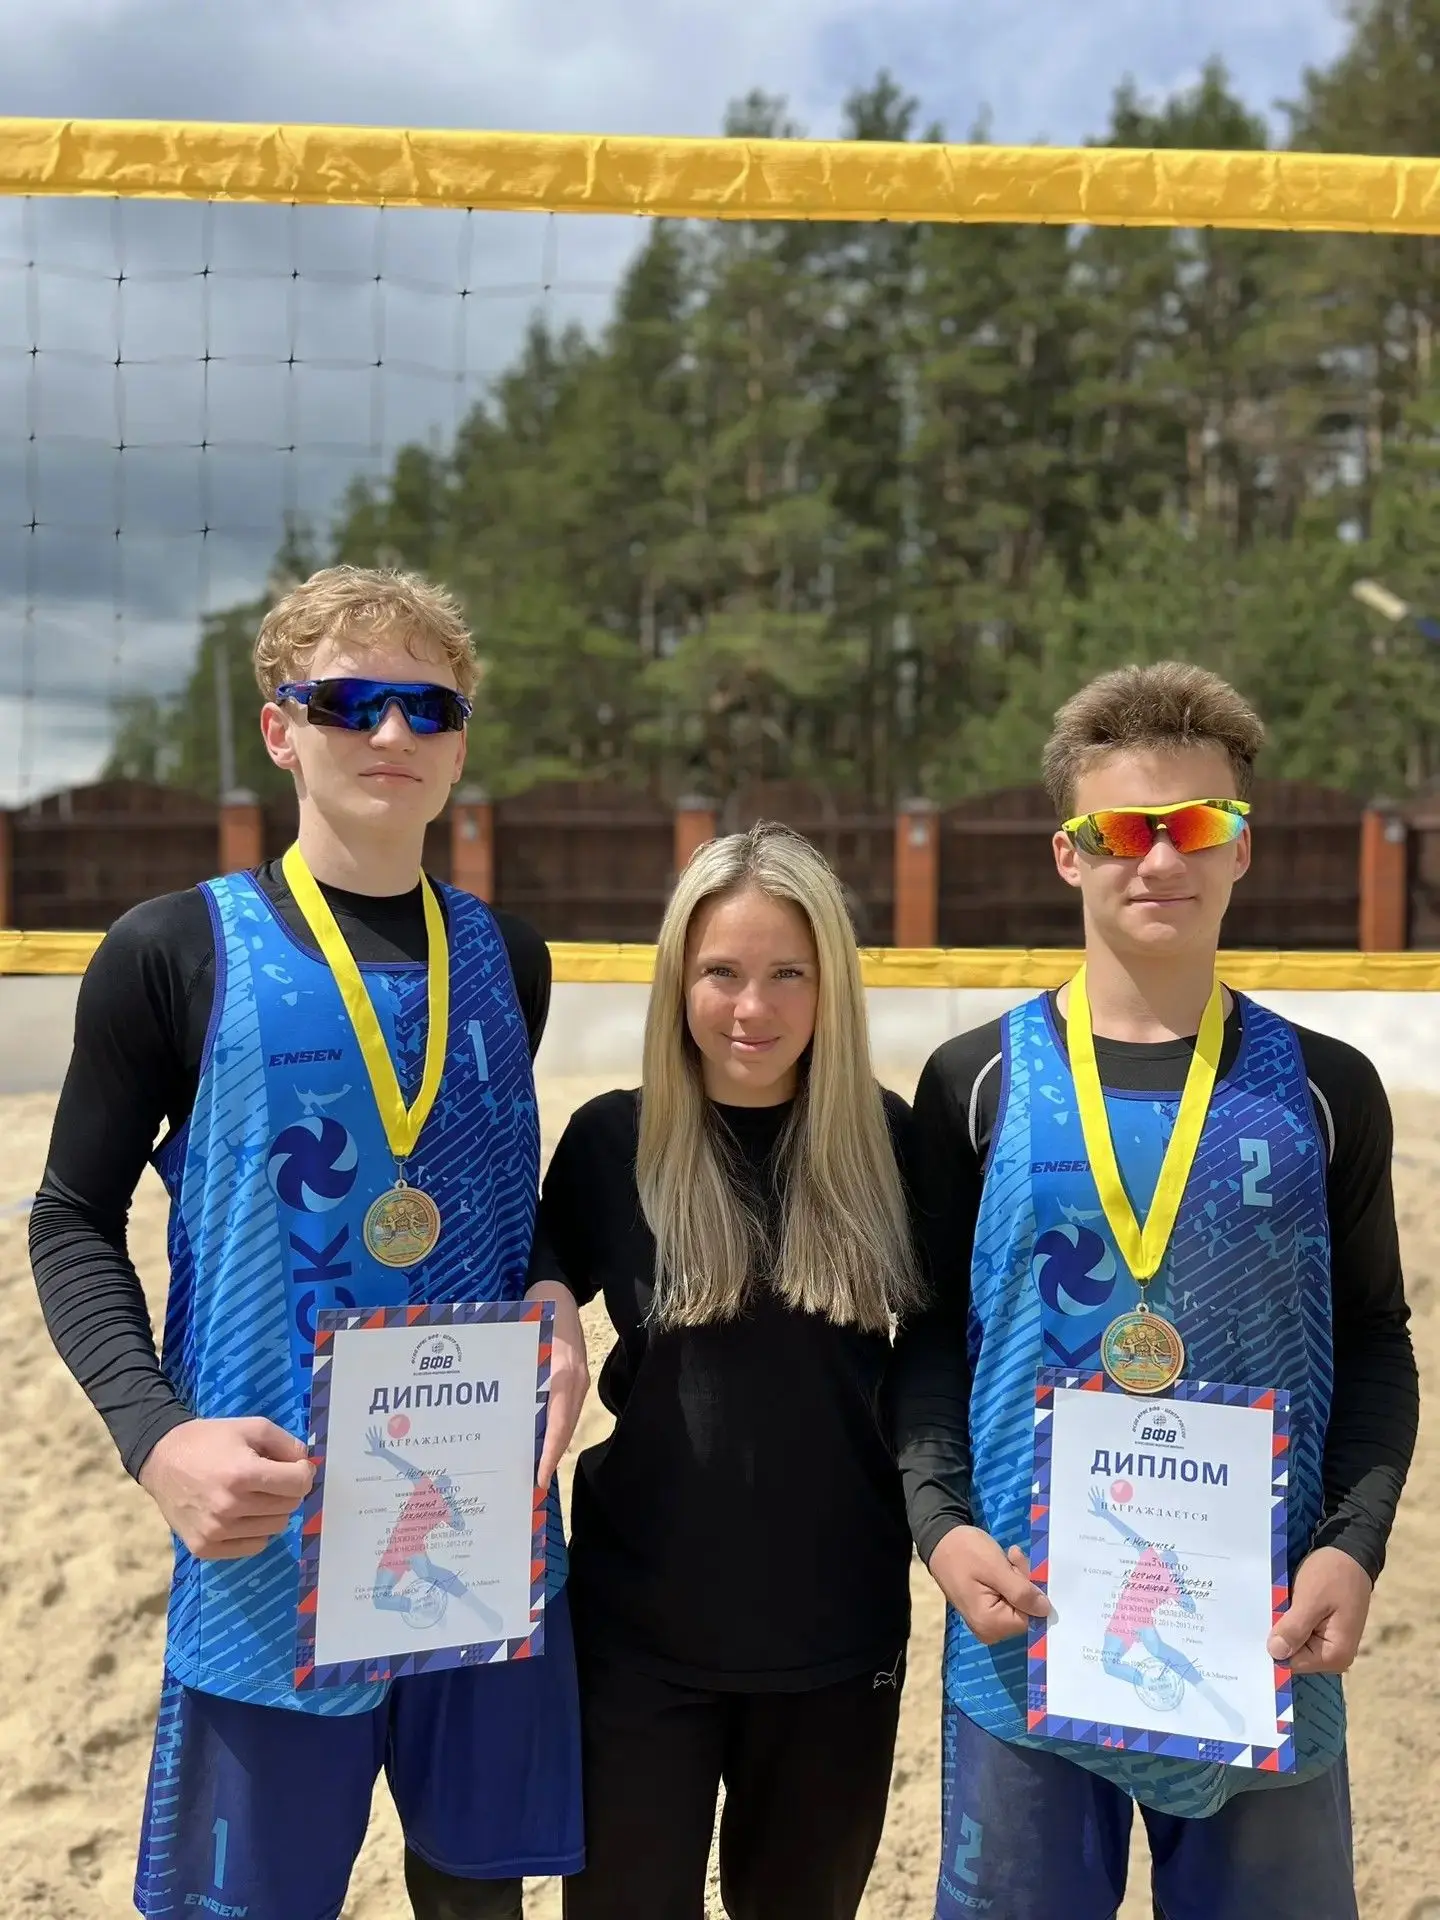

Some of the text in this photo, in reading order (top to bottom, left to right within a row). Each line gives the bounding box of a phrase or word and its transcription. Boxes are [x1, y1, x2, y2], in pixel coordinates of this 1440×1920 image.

[269, 1048, 344, 1067] ENSEN
[466, 1020, 489, 1081] 1
[1031, 1160, 1093, 1174] ENSE
[1238, 1138, 1273, 1207] 2
[419, 1355, 453, 1370] ВФВ
[368, 1379, 499, 1414] ДИПЛОМ
[379, 1432, 480, 1448] НАГРАЖДАЕТСЯ
[1141, 1427, 1176, 1443] ВФВ
[1090, 1449, 1227, 1486] ДИПЛОМ
[1100, 1501, 1208, 1522] НАГРАЖДАЕТСЯ
[212, 1817, 228, 1890] 1
[954, 1811, 984, 1886] 2
[184, 1893, 249, 1918] ENSEN
[941, 1873, 993, 1909] ENSEN
